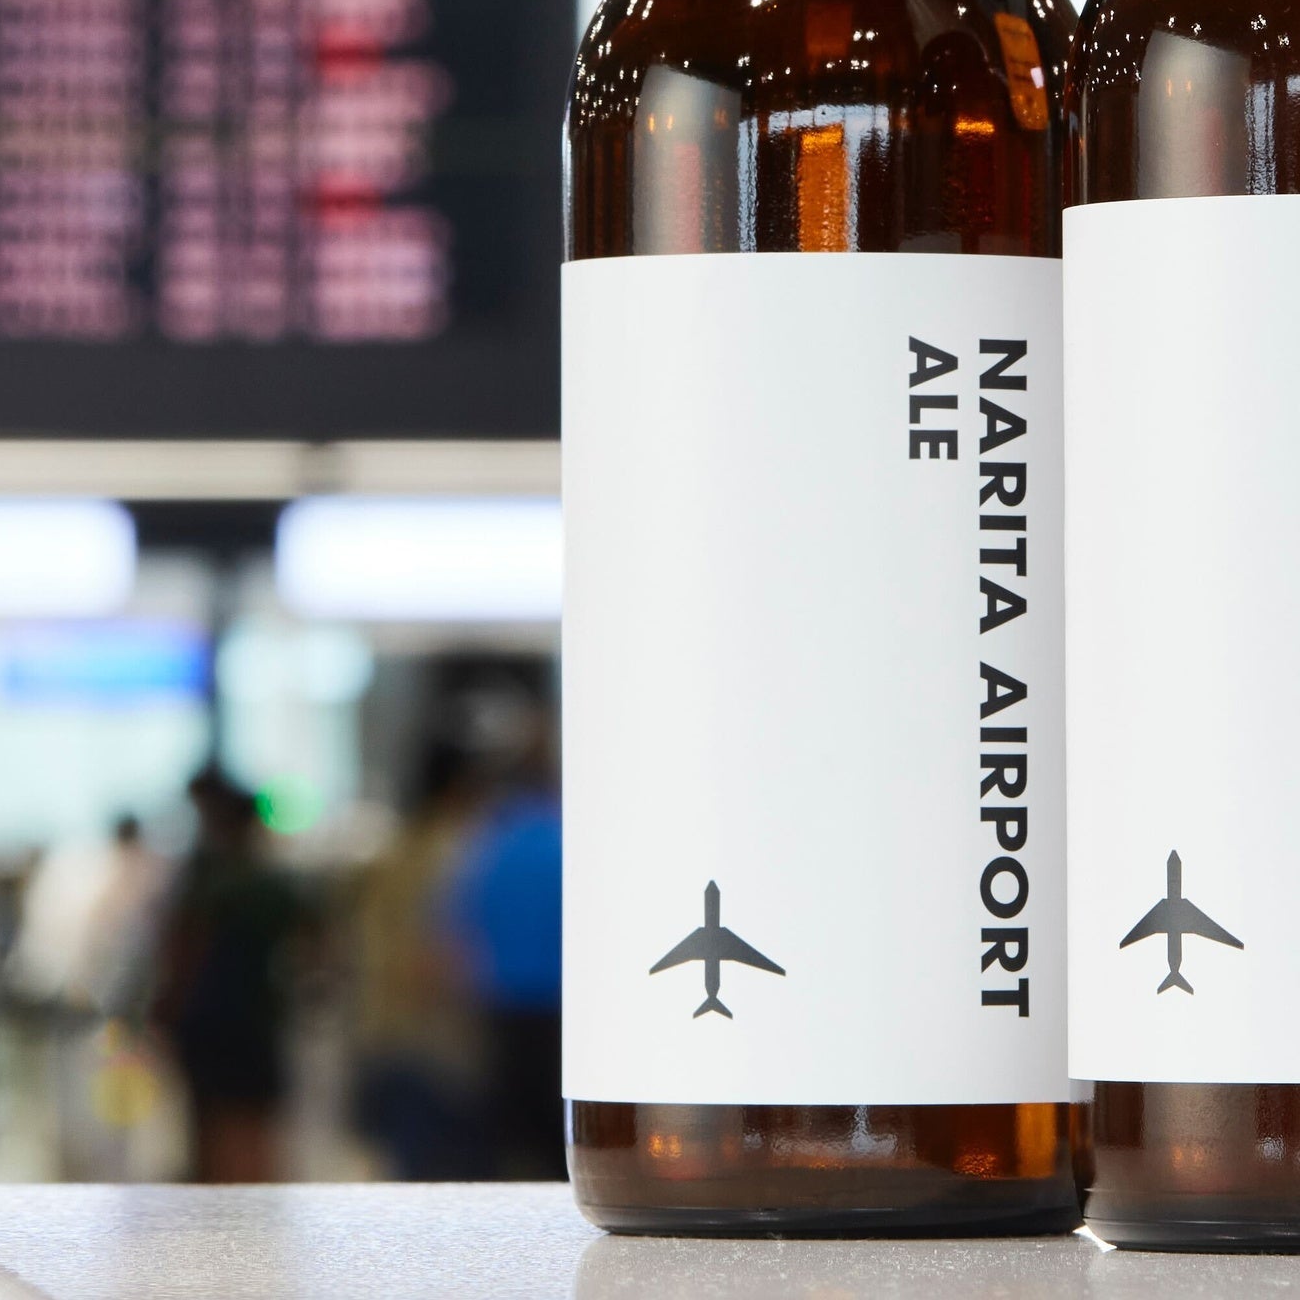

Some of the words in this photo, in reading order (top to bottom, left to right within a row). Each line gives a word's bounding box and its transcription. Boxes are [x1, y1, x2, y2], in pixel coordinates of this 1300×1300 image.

[908, 335, 959, 461] ALE
[979, 338, 1028, 635] NARITA
[979, 661, 1029, 1018] AIRPORT
